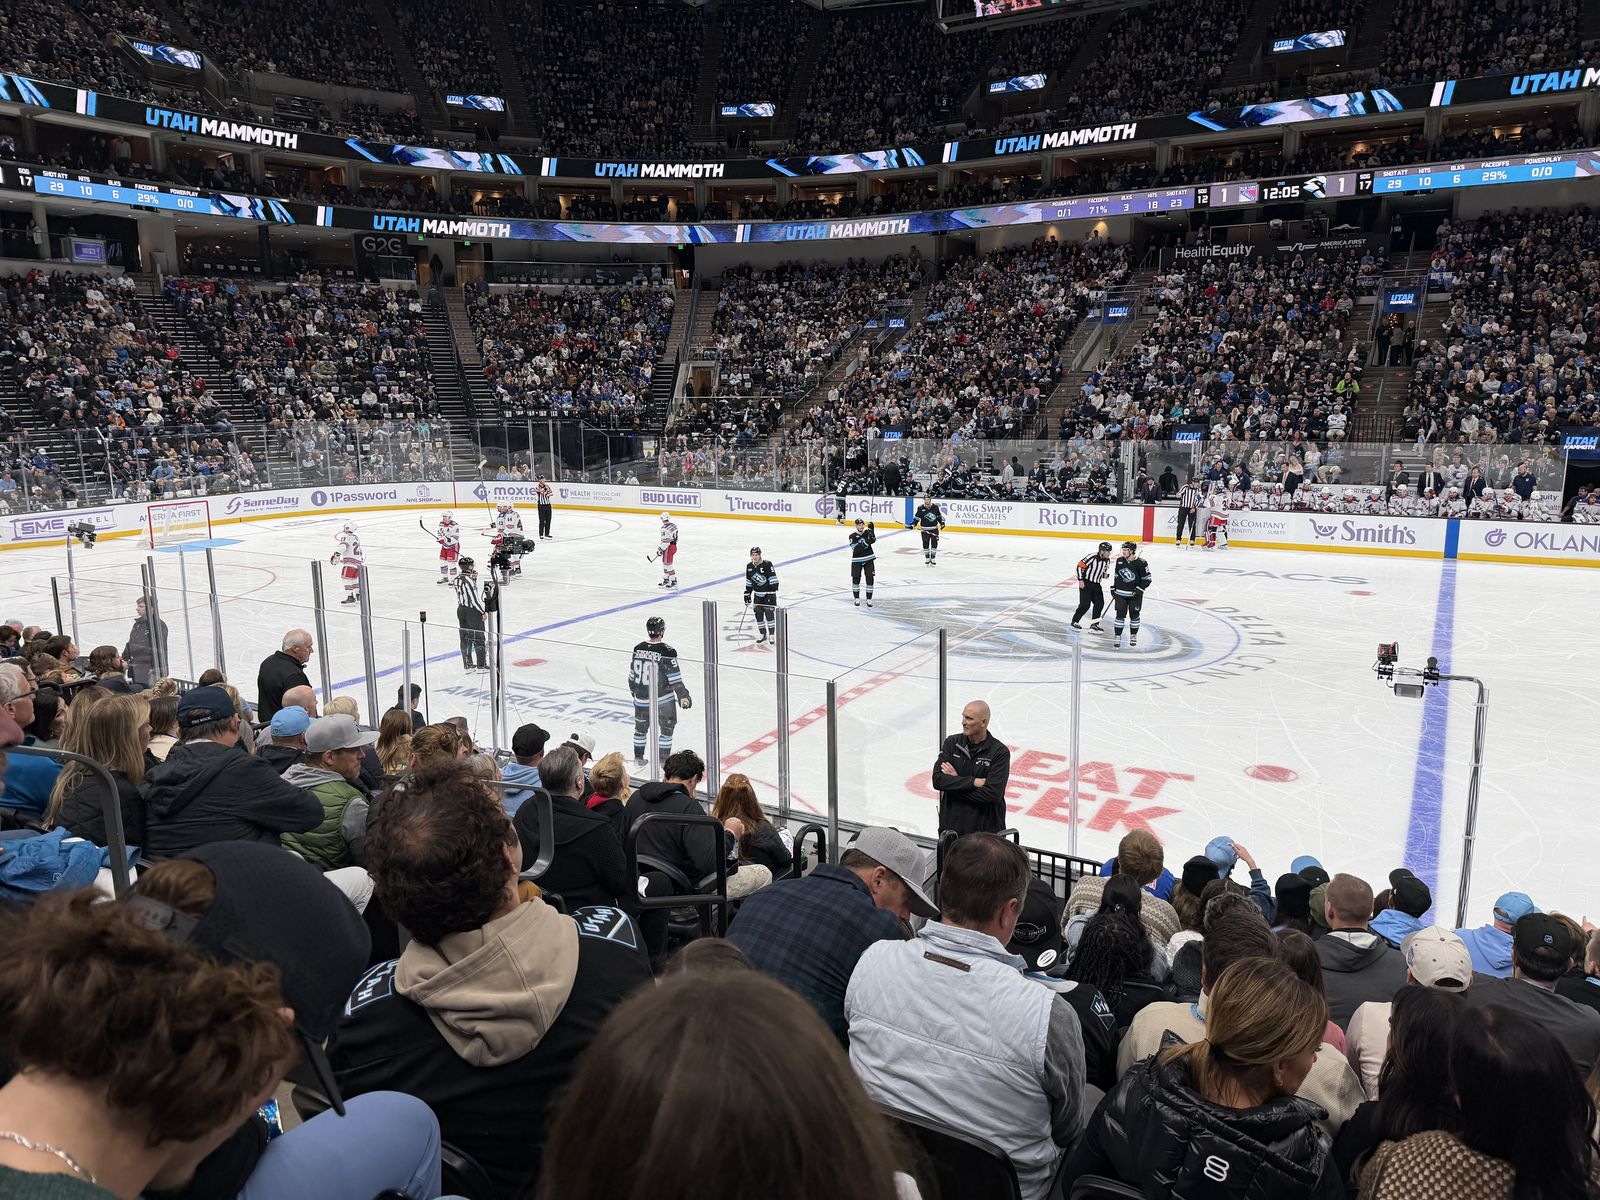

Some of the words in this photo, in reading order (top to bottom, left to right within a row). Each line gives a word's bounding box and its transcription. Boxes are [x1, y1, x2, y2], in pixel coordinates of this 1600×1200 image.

[1511, 69, 1581, 96] UTAH
[146, 107, 198, 134] UTAH
[200, 118, 298, 150] MAMMOTH
[994, 134, 1041, 155] UTAH
[1042, 123, 1137, 150] MAMMOTH
[595, 162, 639, 178] UTAH
[640, 163, 725, 178] MAMMOTH
[19, 175, 33, 187] 17
[1338, 177, 1345, 193] 1
[1359, 180, 1371, 191] 17
[1388, 179, 1402, 189] 29
[1419, 177, 1431, 186] 10
[1453, 174, 1461, 183] 6
[1482, 170, 1508, 181] 29%
[1532, 167, 1553, 177] 0/0
[50, 182, 64, 192] 29
[80, 185, 93, 196] 10
[112, 190, 119, 199] 6
[138, 193, 159, 204] 29%
[177, 198, 194, 209] 0/0
[1197, 195, 1208, 204] 12
[1221, 188, 1227, 203] 1
[1263, 185, 1300, 200] 12:05
[1057, 208, 1071, 218] 0/1
[1089, 205, 1108, 215] 71%
[1123, 203, 1130, 212] 3
[1148, 201, 1158, 210] 18
[1170, 199, 1182, 208] 23
[374, 215, 420, 233] UTAH
[423, 218, 511, 238] MAMMOTH
[786, 224, 828, 240] UTAH
[829, 219, 910, 238] MAMMOTH
[361, 236, 401, 255] G2G
[1319, 240, 1348, 248] AMERICA
[1348, 238, 1367, 246] FIRST
[1175, 244, 1253, 259] HealthEquity
[1109, 306, 1128, 314] UTAH
[884, 431, 903, 439] UTAH
[1175, 432, 1201, 440] UTAH
[1565, 436, 1599, 445] UTAH
[330, 489, 397, 503] 1Password
[494, 486, 537, 496] moxie
[243, 496, 299, 508] SameDay
[642, 492, 666, 503] BUD
[667, 494, 699, 506] LIGHT
[735, 496, 793, 512] Trucordia
[859, 499, 894, 514] Garff
[949, 502, 979, 513] CRAIG
[981, 503, 1013, 514] SWAPP
[962, 512, 1007, 521] ASSOCIATES
[1240, 519, 1286, 529] COMPANY
[21, 519, 65, 535] SME
[1341, 519, 1416, 545] Smith's
[1514, 532, 1600, 553] OKLAN
[1202, 566, 1371, 586] PACS
[1004, 744, 1195, 800] EAT
[583, 907, 614, 933] UTAH
